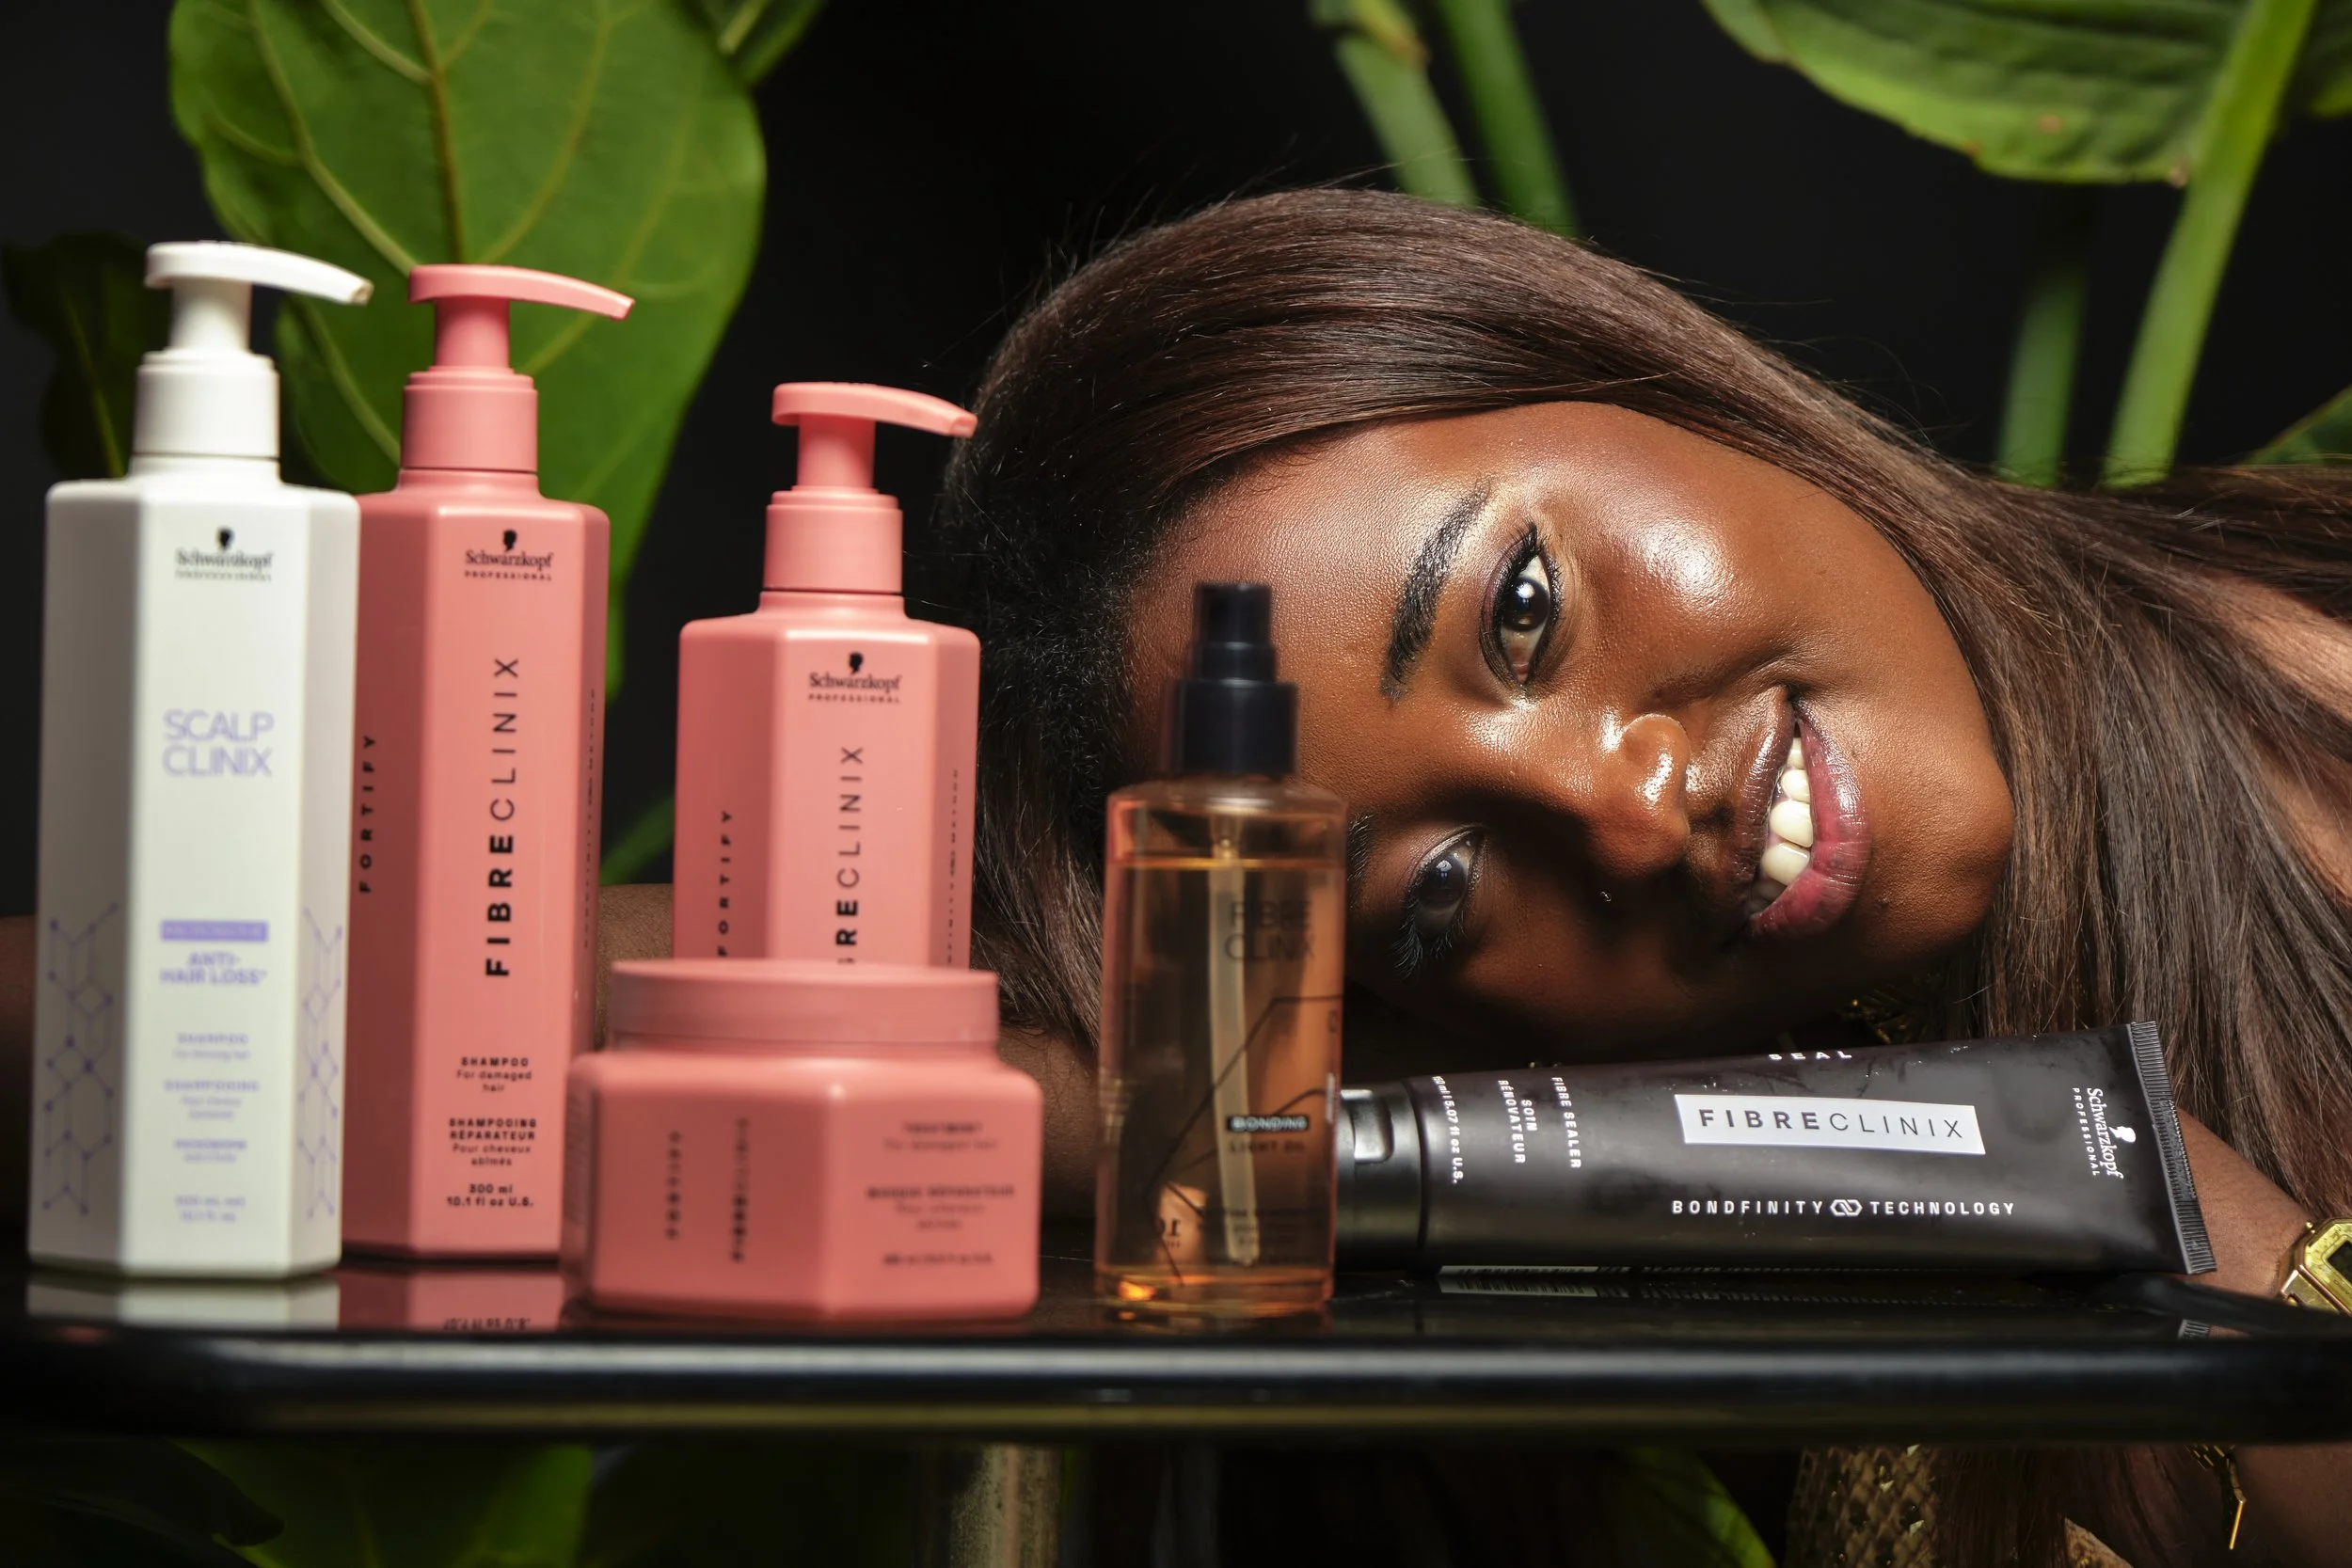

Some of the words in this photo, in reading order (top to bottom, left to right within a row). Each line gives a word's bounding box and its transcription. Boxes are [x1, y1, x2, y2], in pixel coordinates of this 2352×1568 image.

[465, 549, 553, 571] Schwarzkopf
[464, 570, 552, 581] PROFESSIONAL
[809, 673, 901, 693] Schwarzkopf
[163, 708, 275, 741] SCALP
[162, 745, 273, 777] CLINIX
[358, 736, 375, 894] FORTIFY
[485, 658, 518, 976] FIBRECLINIX
[836, 747, 864, 965] RECLINIX
[717, 810, 732, 958] FORTIFY
[462, 1057, 529, 1067] SHAMPOO
[1769, 1051, 1852, 1061] SEAL
[457, 1070, 475, 1080] For
[479, 1070, 532, 1082] damaged
[483, 1084, 504, 1092] hair
[450, 1118, 537, 1128] SHAMPOOING
[1499, 1080, 1526, 1164] RÉNOVATEUR
[1521, 1100, 1537, 1132] SOIN
[1552, 1076, 1572, 1108] FIBRE
[1564, 1112, 1581, 1168] SEALER
[1699, 1109, 1963, 1138] FIBRECLINIX
[450, 1131, 535, 1140] RÉPARATEUR
[2073, 1087, 2100, 1176] PROFESSIONAL
[2087, 1087, 2123, 1179] Schwarzkopf
[453, 1144, 479, 1153] Pour
[483, 1144, 531, 1153] cheveux
[1451, 1139, 1460, 1153] oz
[1452, 1157, 1464, 1184] U.S.
[469, 1183, 494, 1195] 300
[499, 1183, 513, 1195] ml
[447, 1196, 471, 1207] 10.1
[476, 1196, 485, 1207] fl
[490, 1198, 503, 1208] oz
[509, 1196, 533, 1208] U.S.
[1673, 1199, 1823, 1215] BONDFINITY
[1870, 1200, 2014, 1216] TECHNOLOGY
